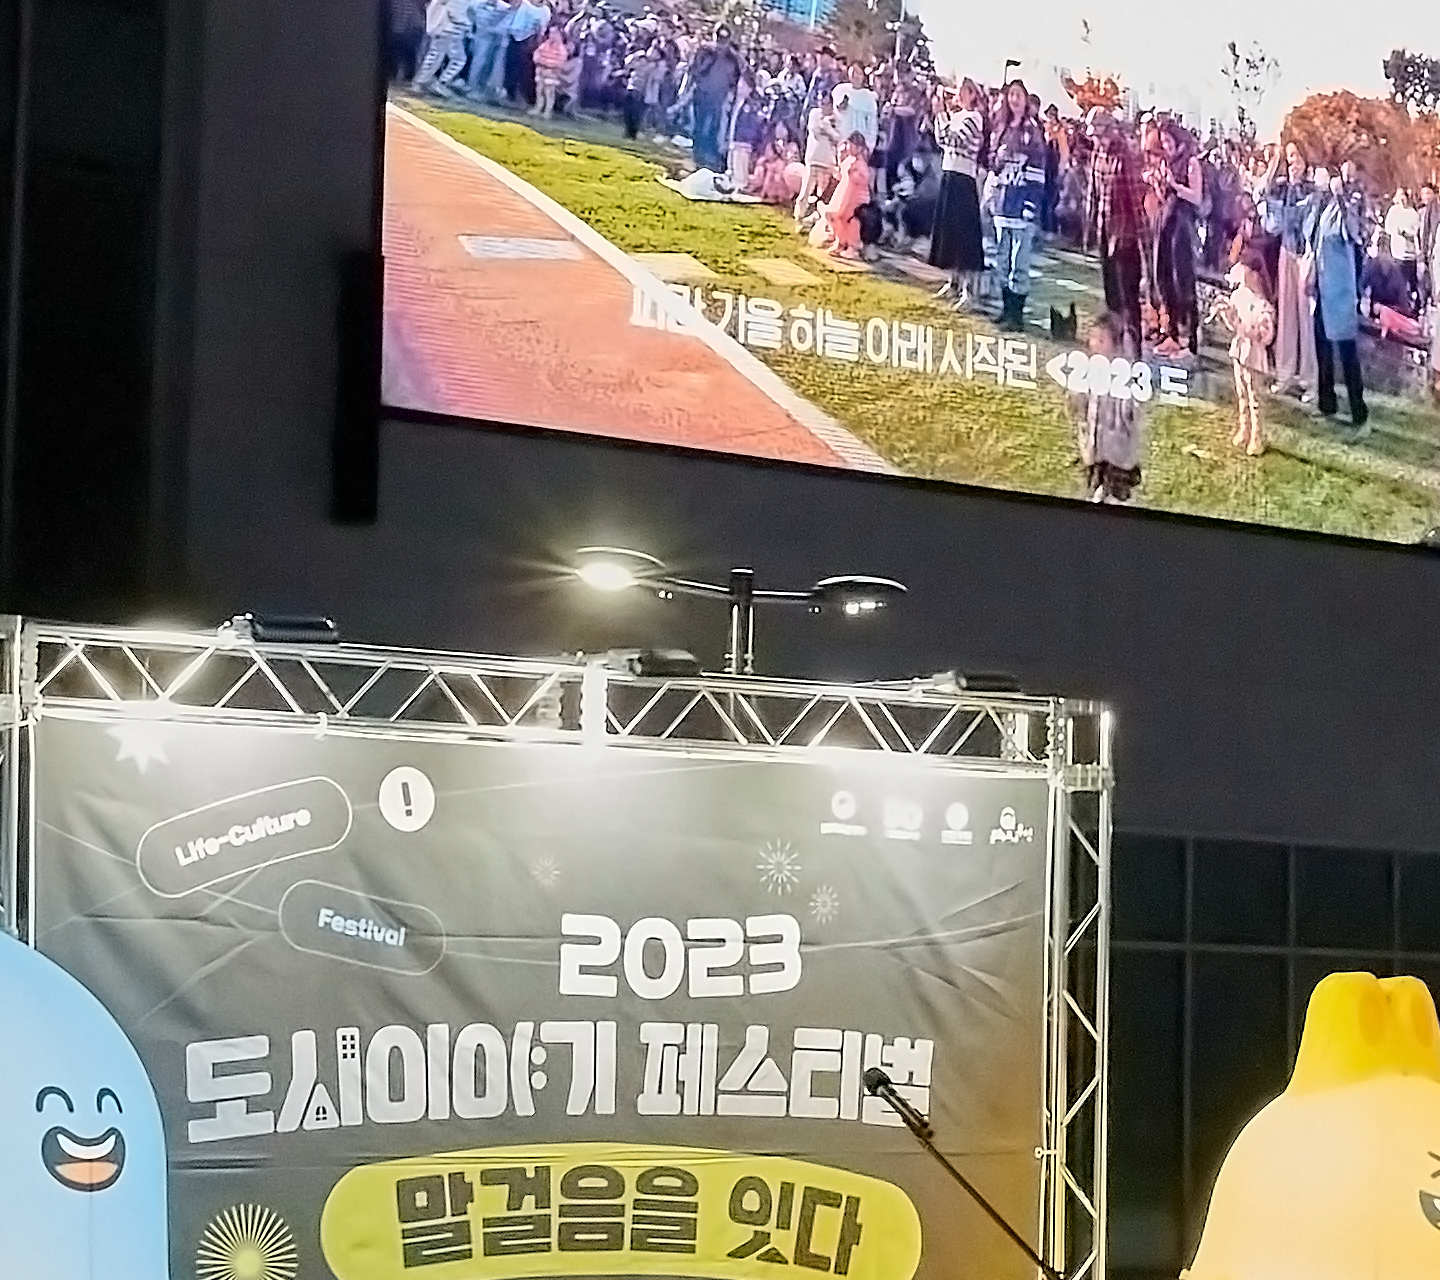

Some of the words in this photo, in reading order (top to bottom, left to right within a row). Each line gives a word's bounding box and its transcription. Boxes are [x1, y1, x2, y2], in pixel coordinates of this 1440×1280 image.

[790, 303, 859, 362] 하늘
[866, 317, 933, 375] 아래
[939, 329, 1037, 389] 시작된
[175, 808, 312, 867] Life-Culture
[318, 907, 407, 947] Festival
[559, 912, 803, 1001] 2023
[185, 1020, 618, 1144] 도시이야기
[637, 1022, 935, 1128] 페스티벌
[396, 1164, 700, 1269] 말걸음을
[725, 1174, 863, 1277] 잇다
